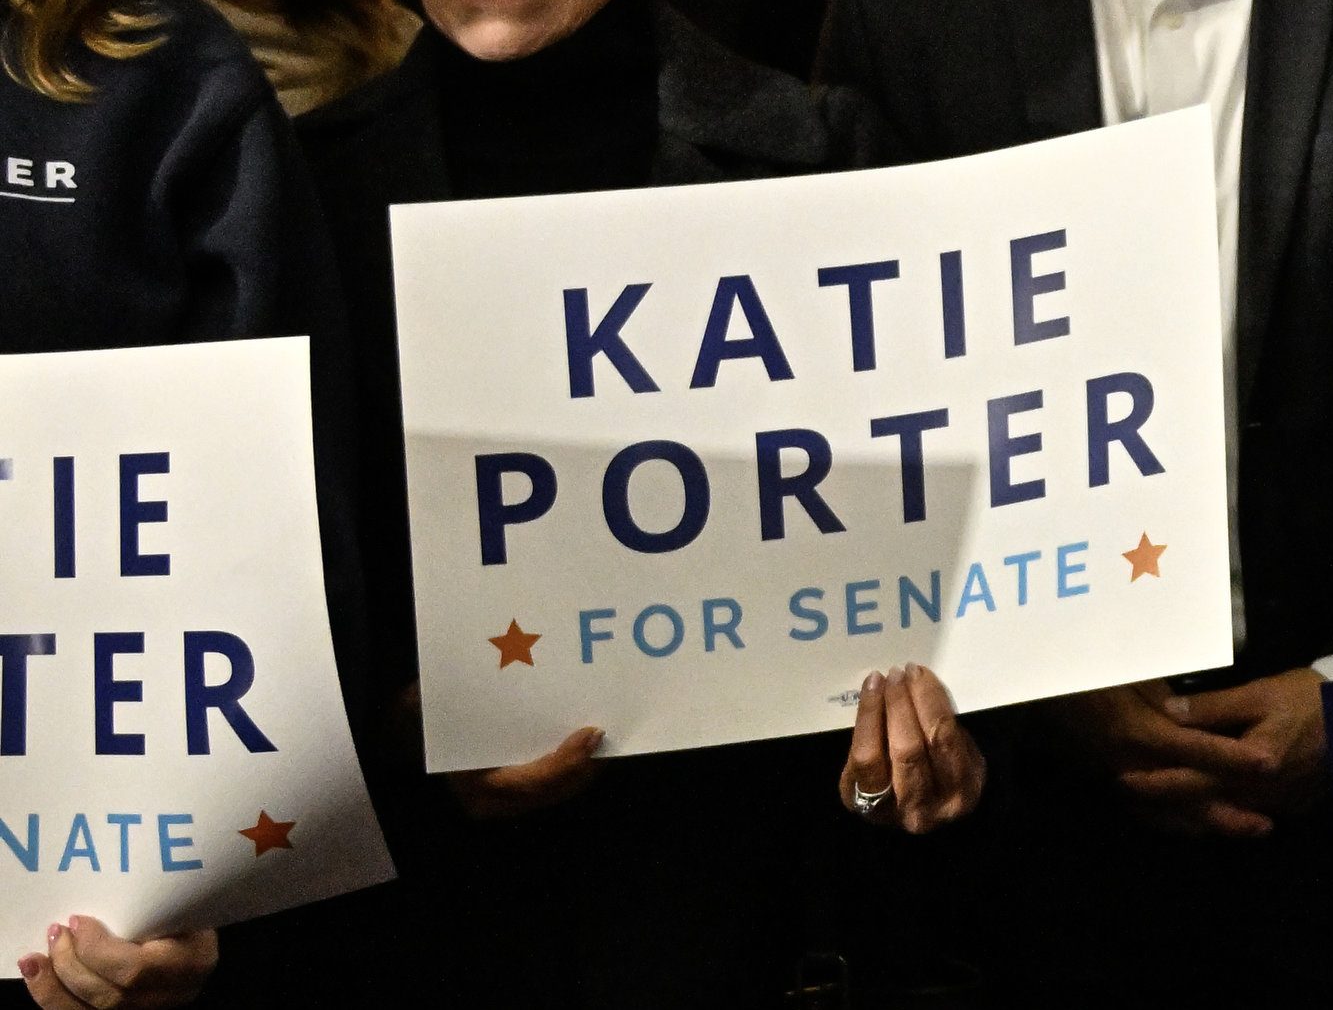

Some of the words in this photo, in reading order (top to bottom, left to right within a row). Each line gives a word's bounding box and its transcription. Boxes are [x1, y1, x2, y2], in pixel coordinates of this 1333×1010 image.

[6, 156, 78, 189] ER
[561, 227, 1071, 399] KATIE
[0, 451, 172, 579] IE
[474, 371, 1167, 567] PORTER
[578, 597, 746, 664] FOR
[788, 540, 1091, 641] SENATE
[0, 630, 279, 757] TER
